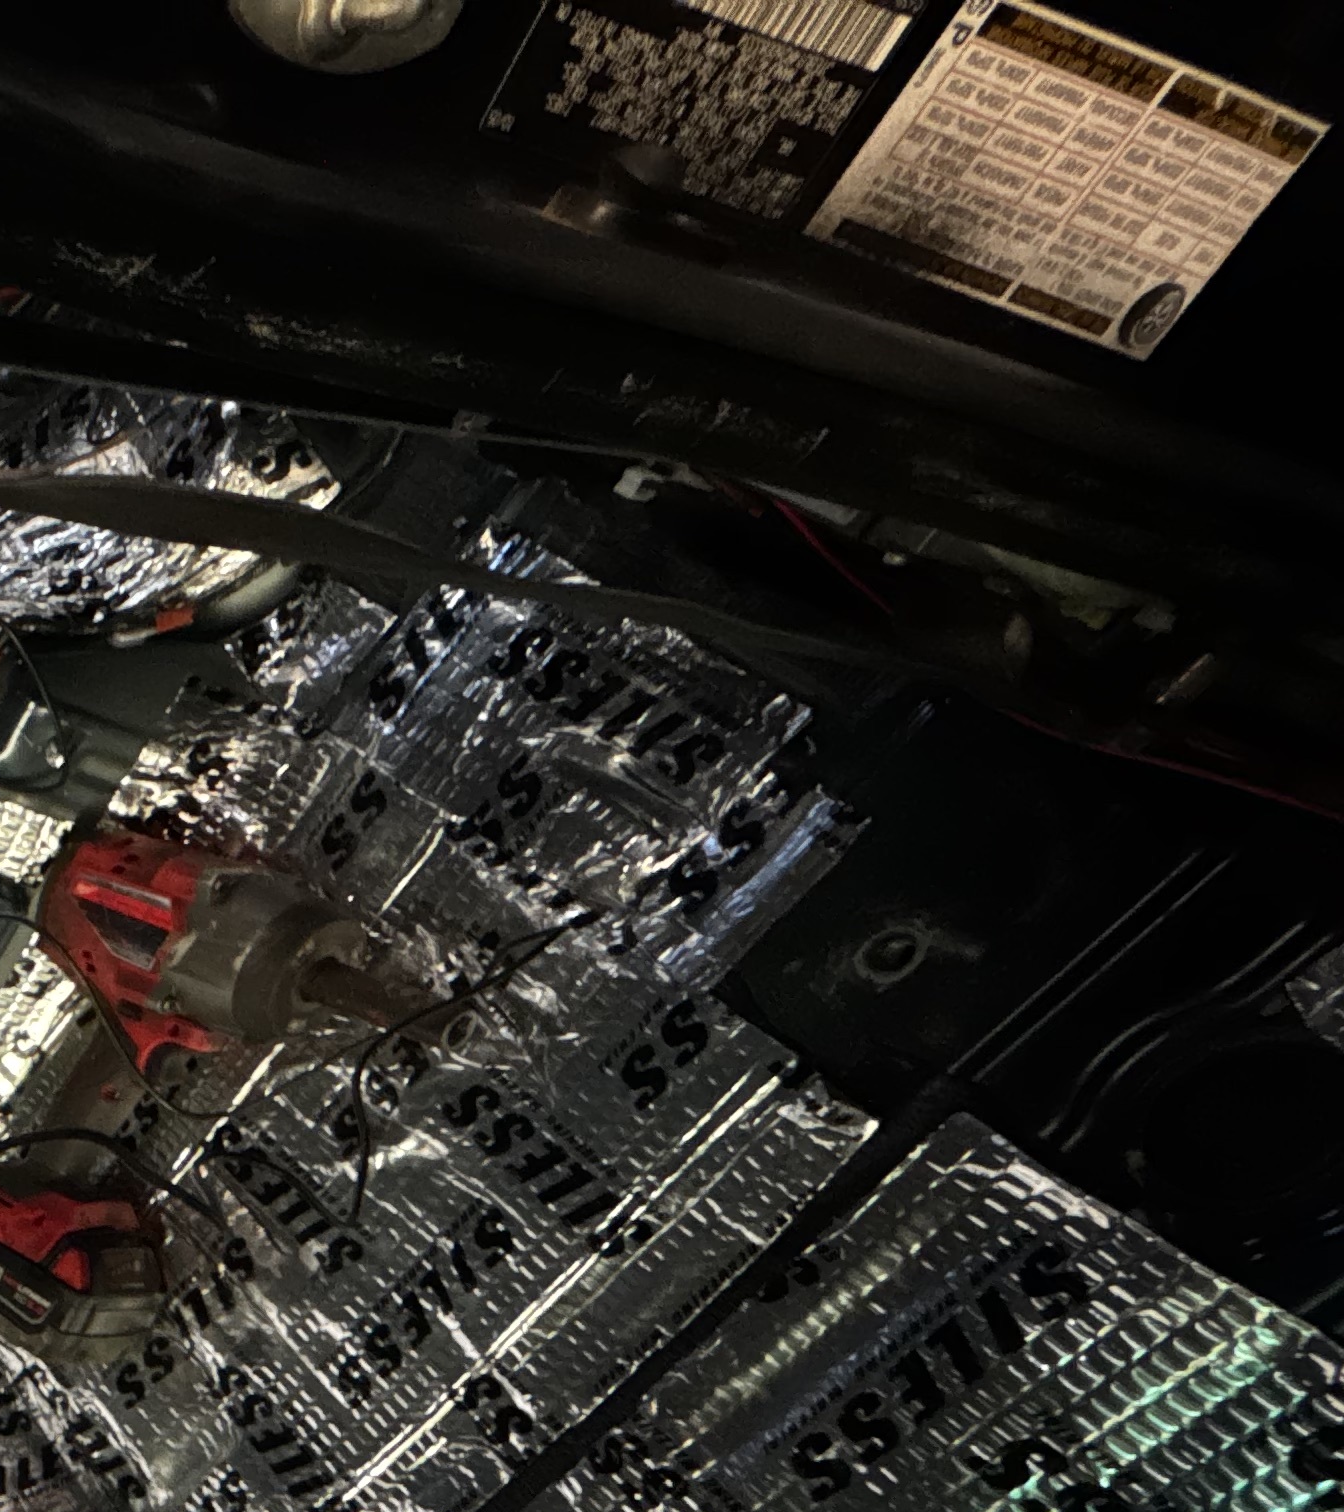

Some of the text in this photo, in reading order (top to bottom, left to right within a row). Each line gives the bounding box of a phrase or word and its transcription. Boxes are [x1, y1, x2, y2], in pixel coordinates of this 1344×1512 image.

[487, 627, 726, 786] SILESS
[442, 1085, 654, 1257] SILESS
[790, 1246, 1089, 1501] SILESS
